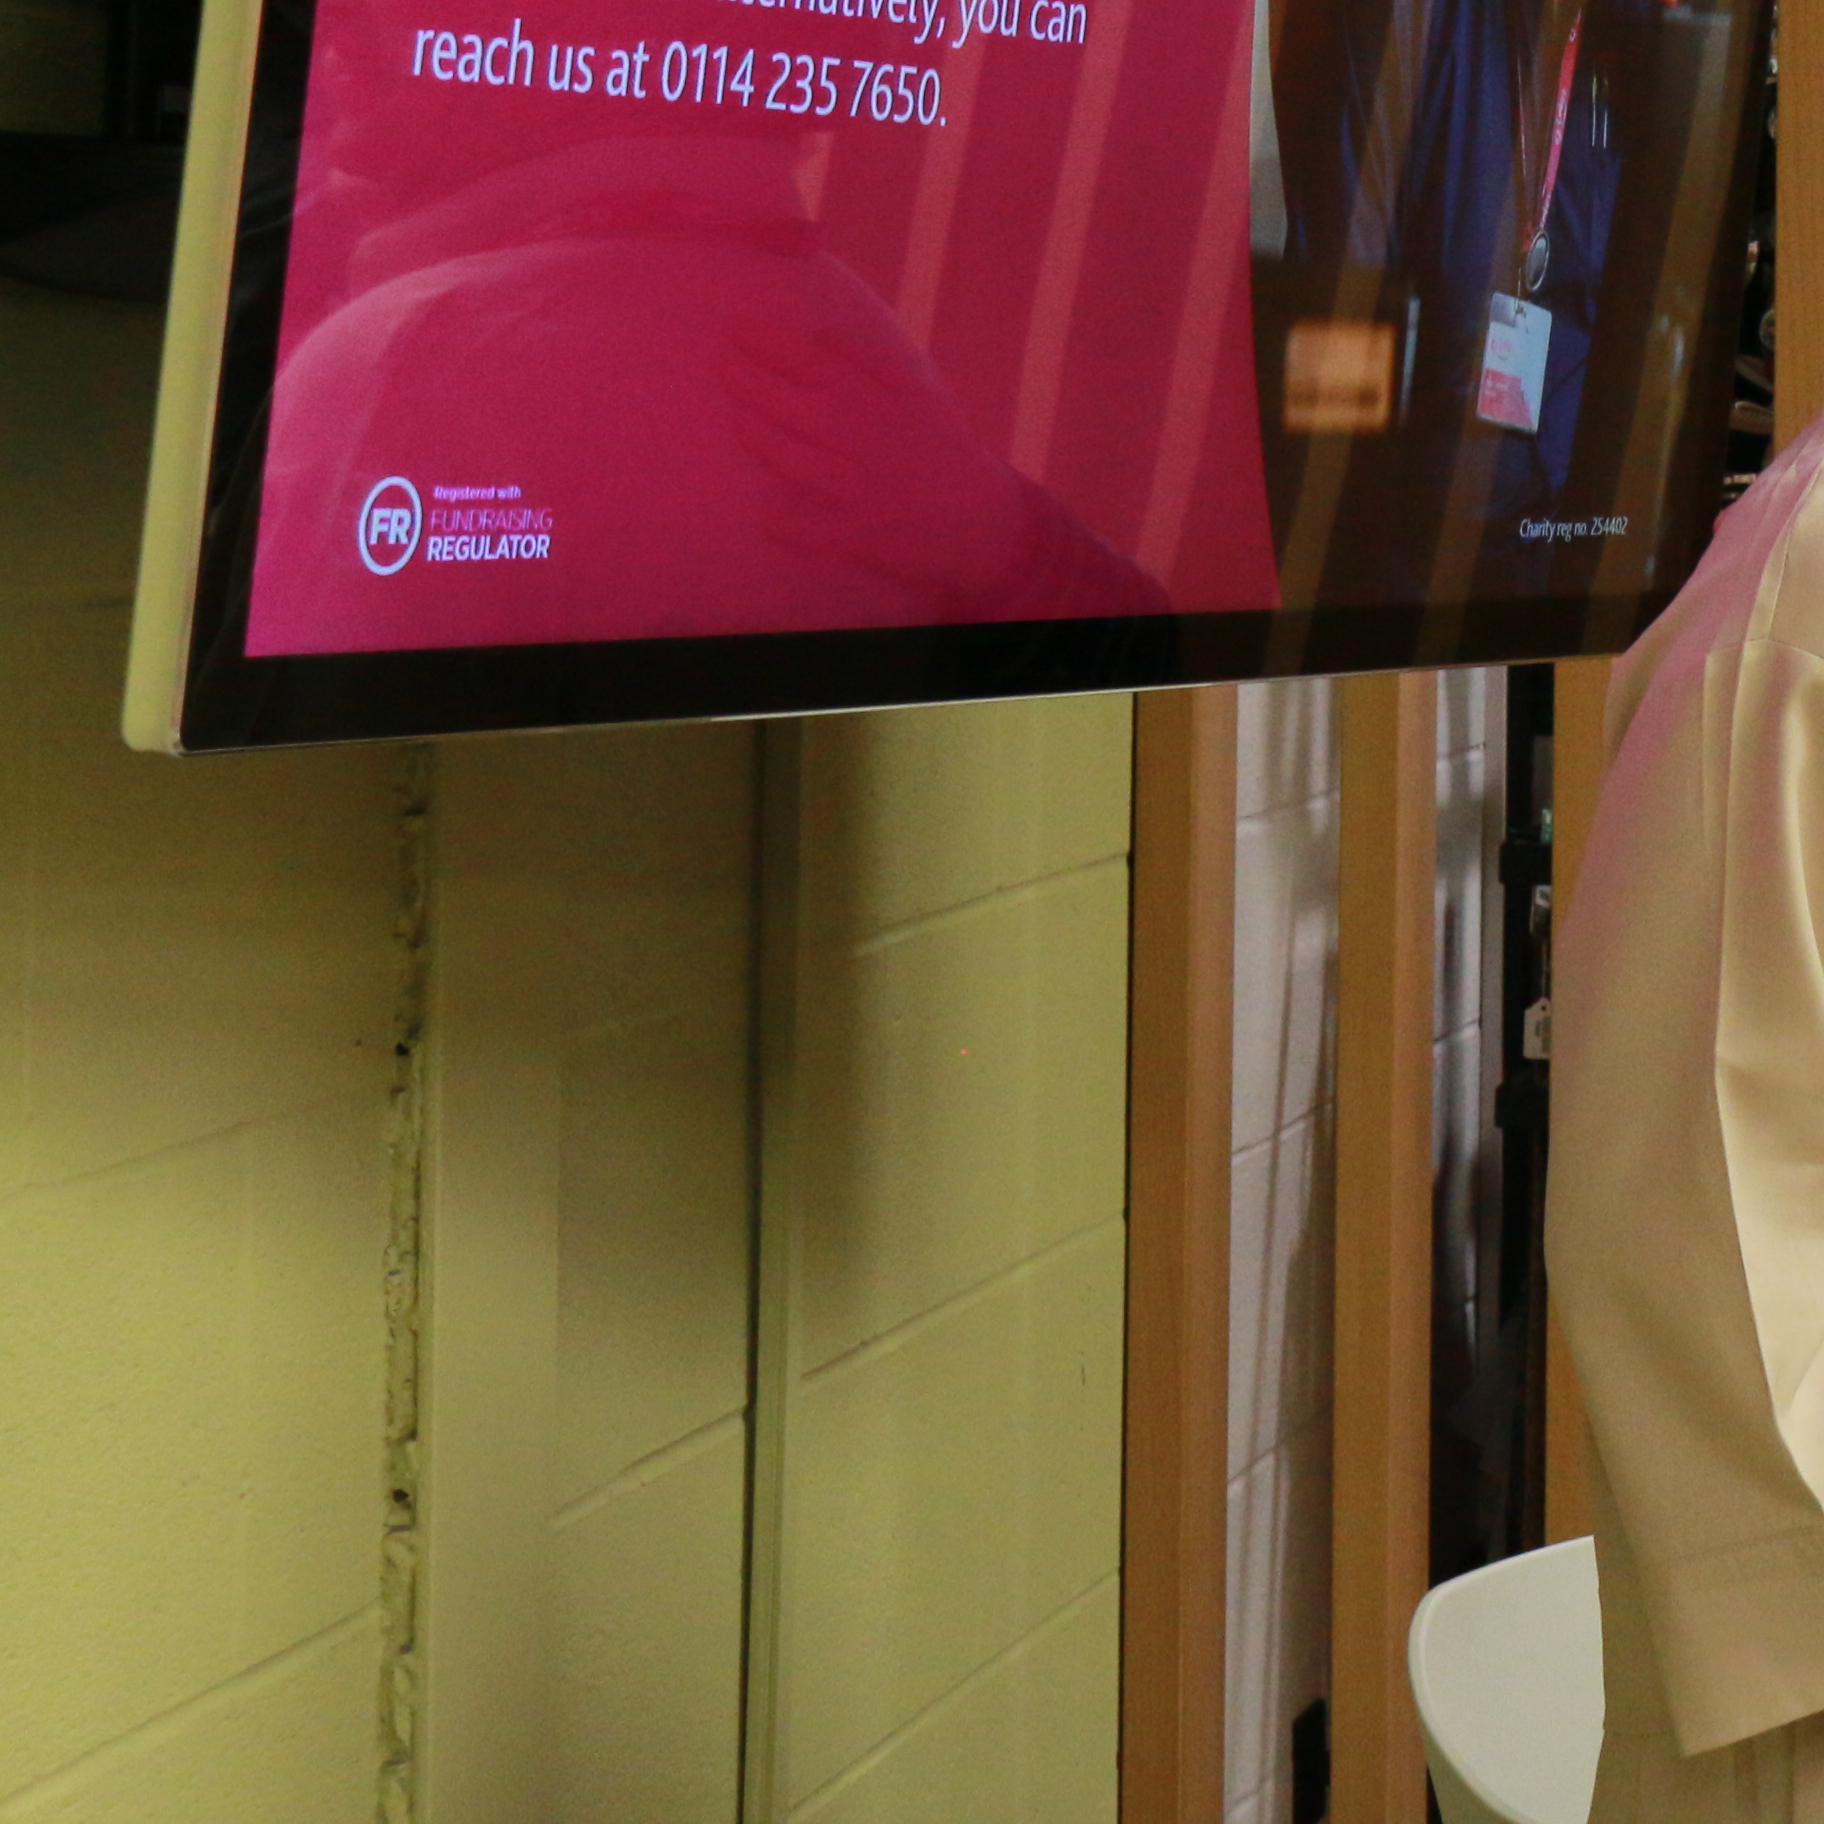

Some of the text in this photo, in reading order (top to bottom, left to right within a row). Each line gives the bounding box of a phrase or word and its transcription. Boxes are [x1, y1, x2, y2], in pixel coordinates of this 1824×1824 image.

[1030, 0, 1087, 44] can
[413, 18, 946, 127] reach us at 0114 235 7650.
[433, 485, 521, 502] Registered with
[369, 507, 413, 546] FR
[430, 508, 554, 533] FUNDRAISING
[1519, 516, 1629, 543] Charity reg no. 254402
[426, 534, 551, 562] REGULATOR
